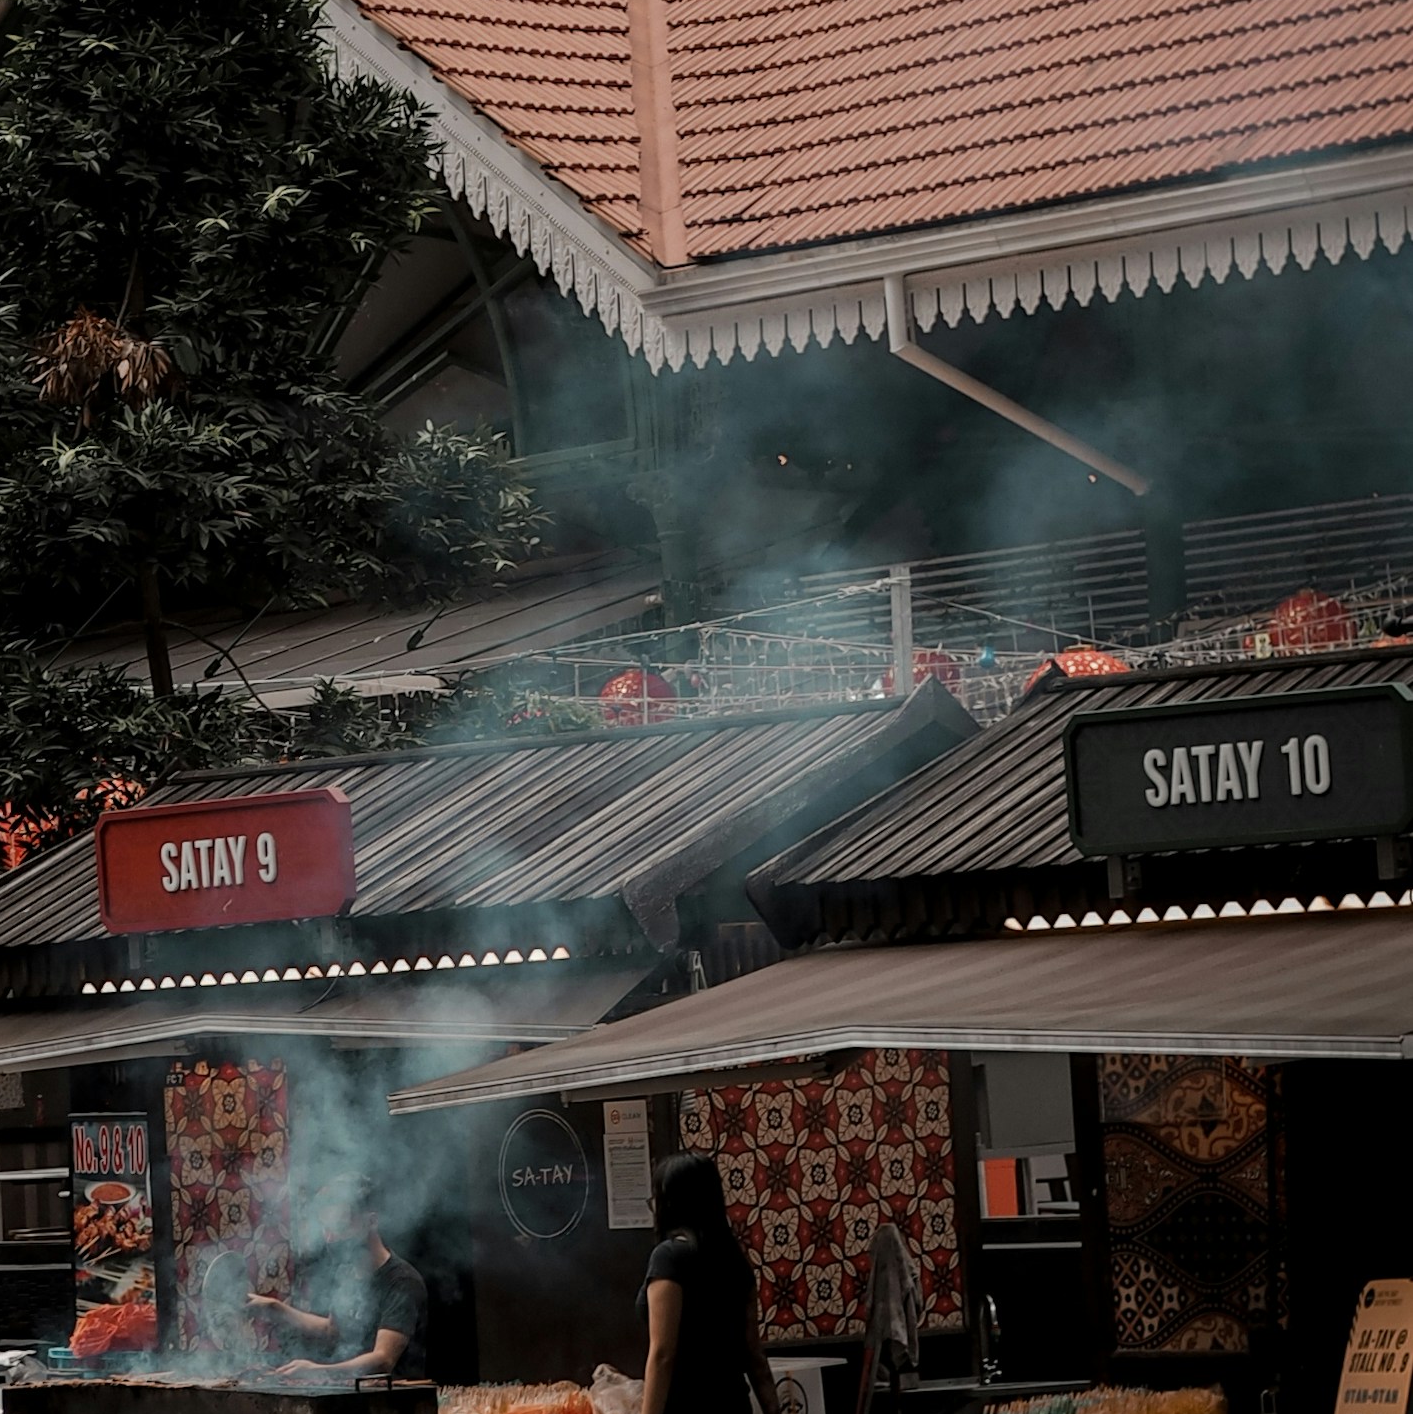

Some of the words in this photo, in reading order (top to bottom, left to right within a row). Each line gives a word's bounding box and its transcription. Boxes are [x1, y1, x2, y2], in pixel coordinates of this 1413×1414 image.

[1142, 740, 1264, 808] SATAY
[1280, 734, 1332, 796] 10
[160, 835, 247, 893] SATAY
[256, 832, 278, 883] 9
[112, 1125, 125, 1175] &
[126, 1125, 147, 1175] 10
[512, 1164, 573, 1187] SA-TAY
[1358, 1329, 1397, 1349] SA-TAY
[1395, 1329, 1408, 1350] @
[1348, 1352, 1378, 1373] STALL
